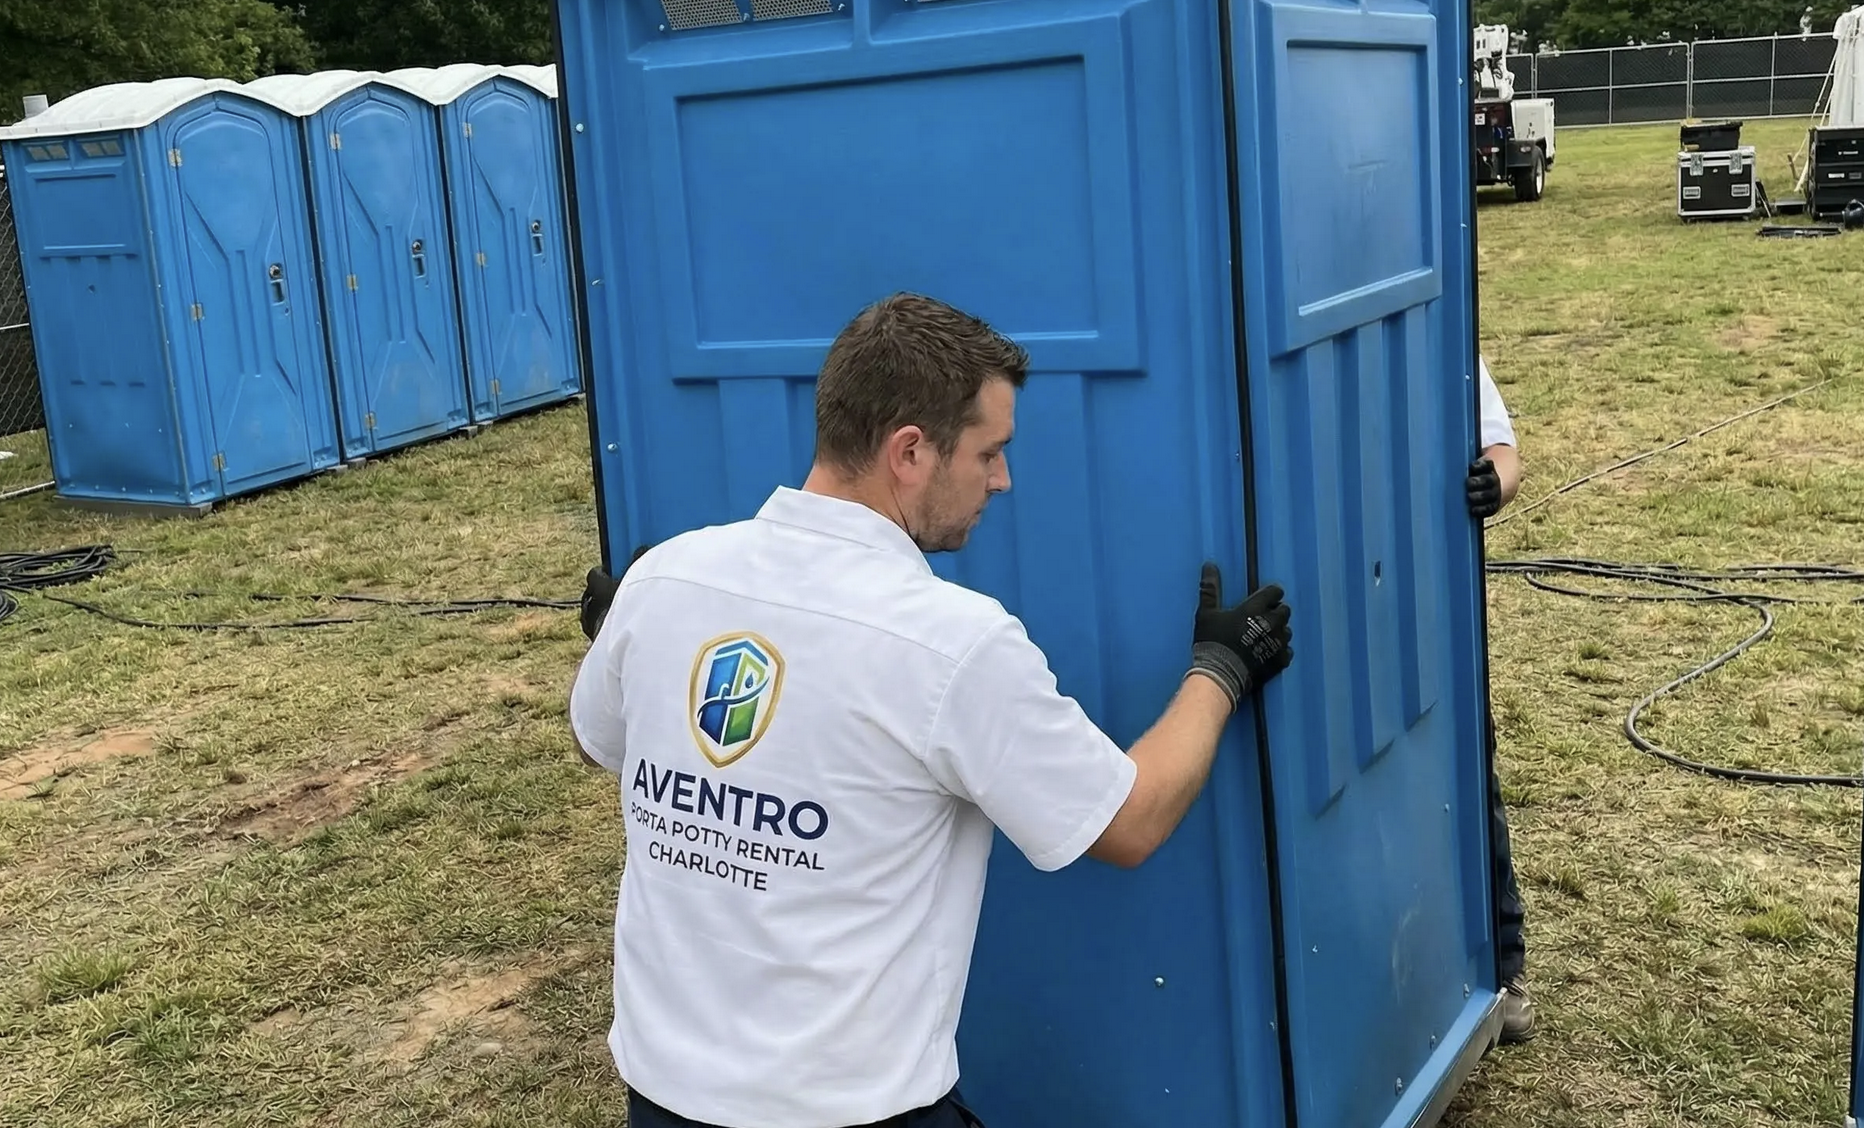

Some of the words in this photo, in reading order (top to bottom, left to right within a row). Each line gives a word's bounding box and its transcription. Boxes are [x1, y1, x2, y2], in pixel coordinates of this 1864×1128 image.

[633, 758, 829, 841] AVENTRO
[649, 841, 768, 891] CHARLOTTE
[671, 820, 732, 852] POTTY
[737, 838, 825, 871] RENTAL
